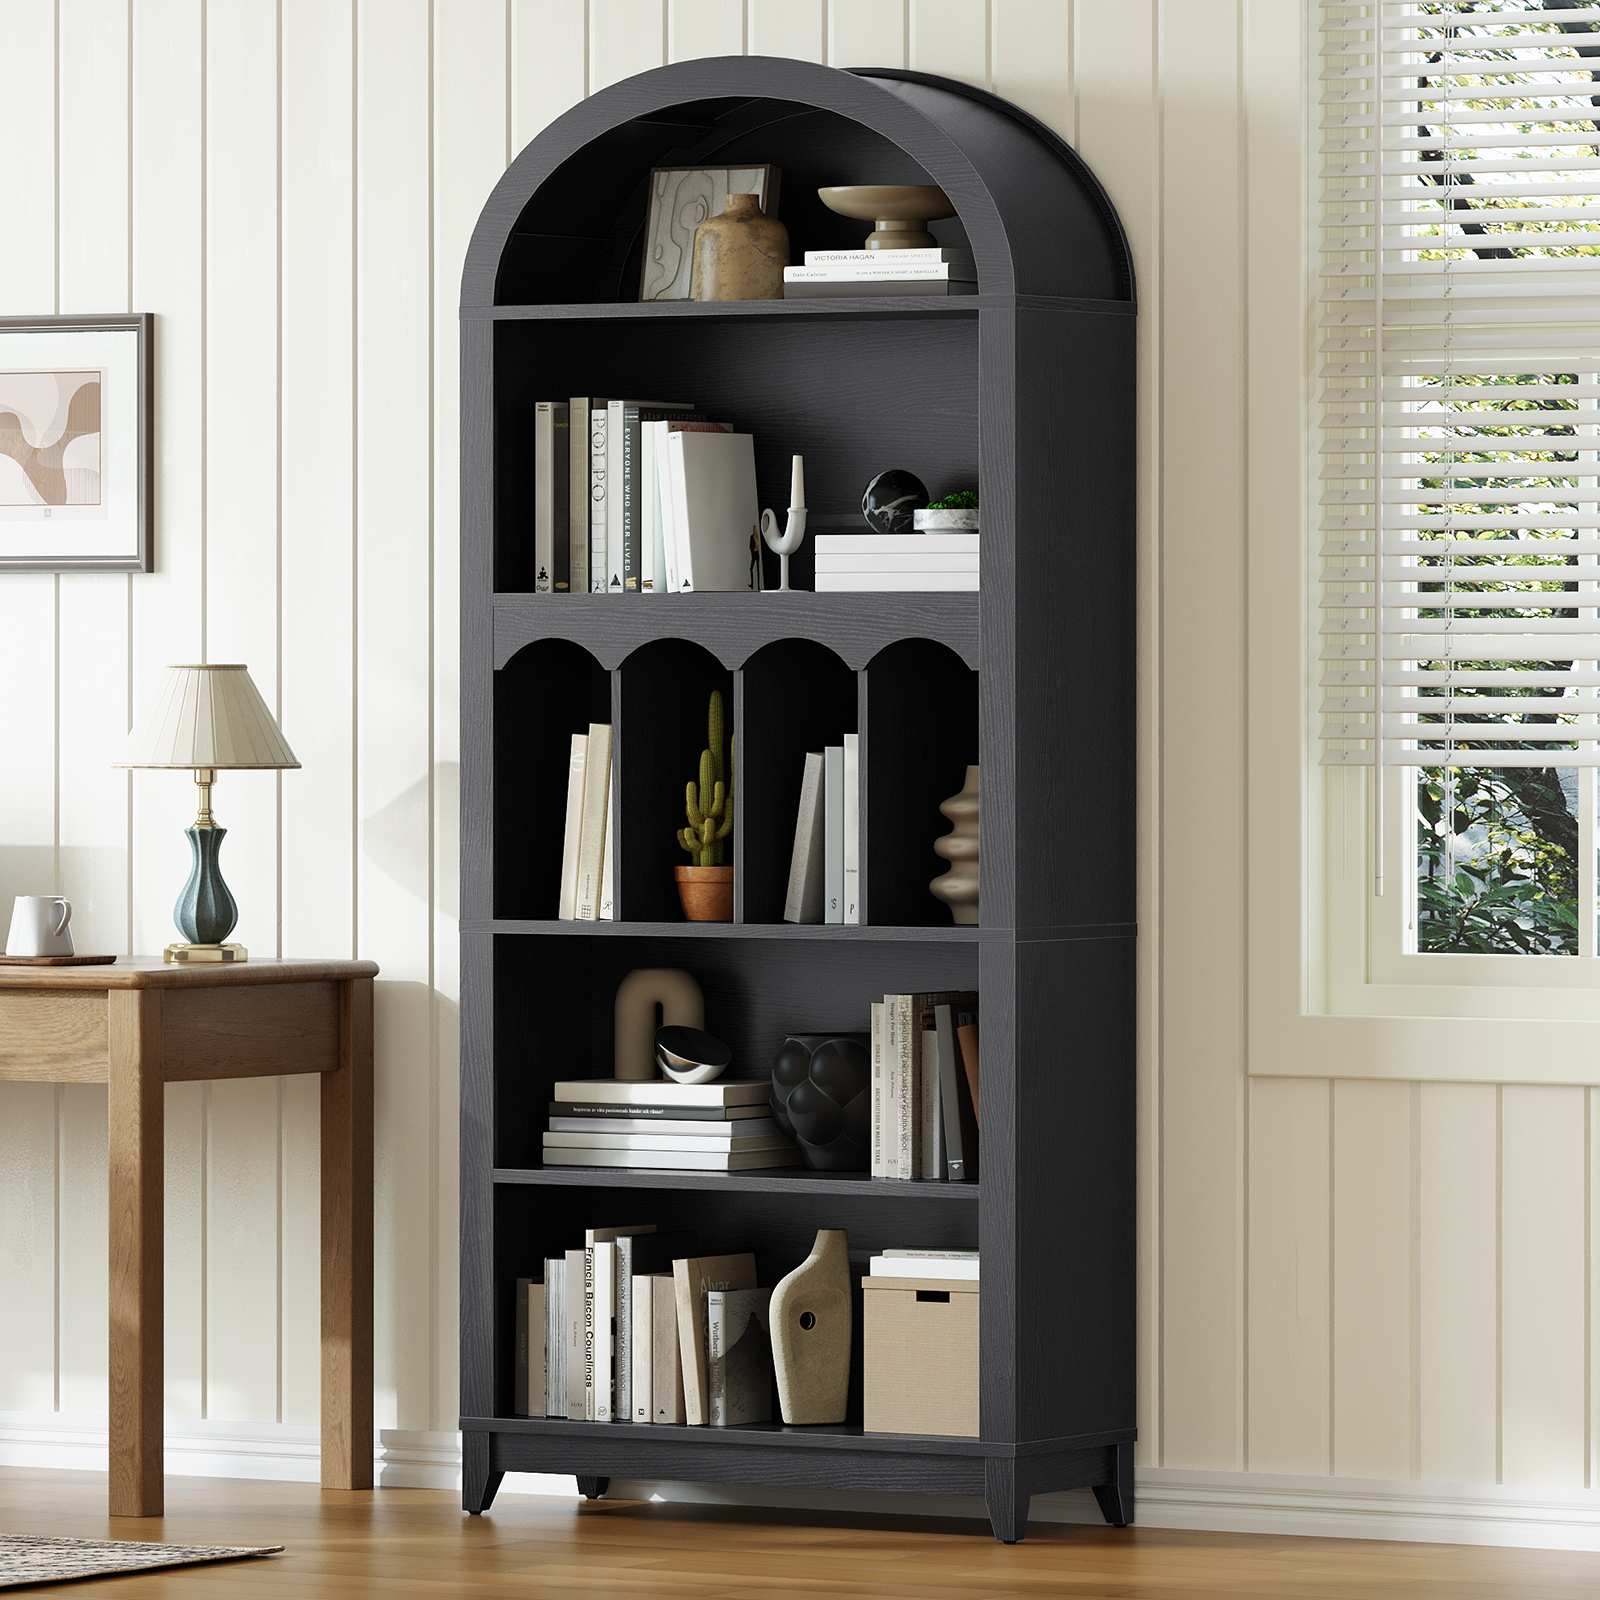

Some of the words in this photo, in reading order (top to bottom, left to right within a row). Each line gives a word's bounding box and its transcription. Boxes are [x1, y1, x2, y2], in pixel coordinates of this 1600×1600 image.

[585, 1247, 594, 1287] Francis
[585, 1292, 594, 1327] Bacon
[585, 1331, 594, 1388] Couplings
